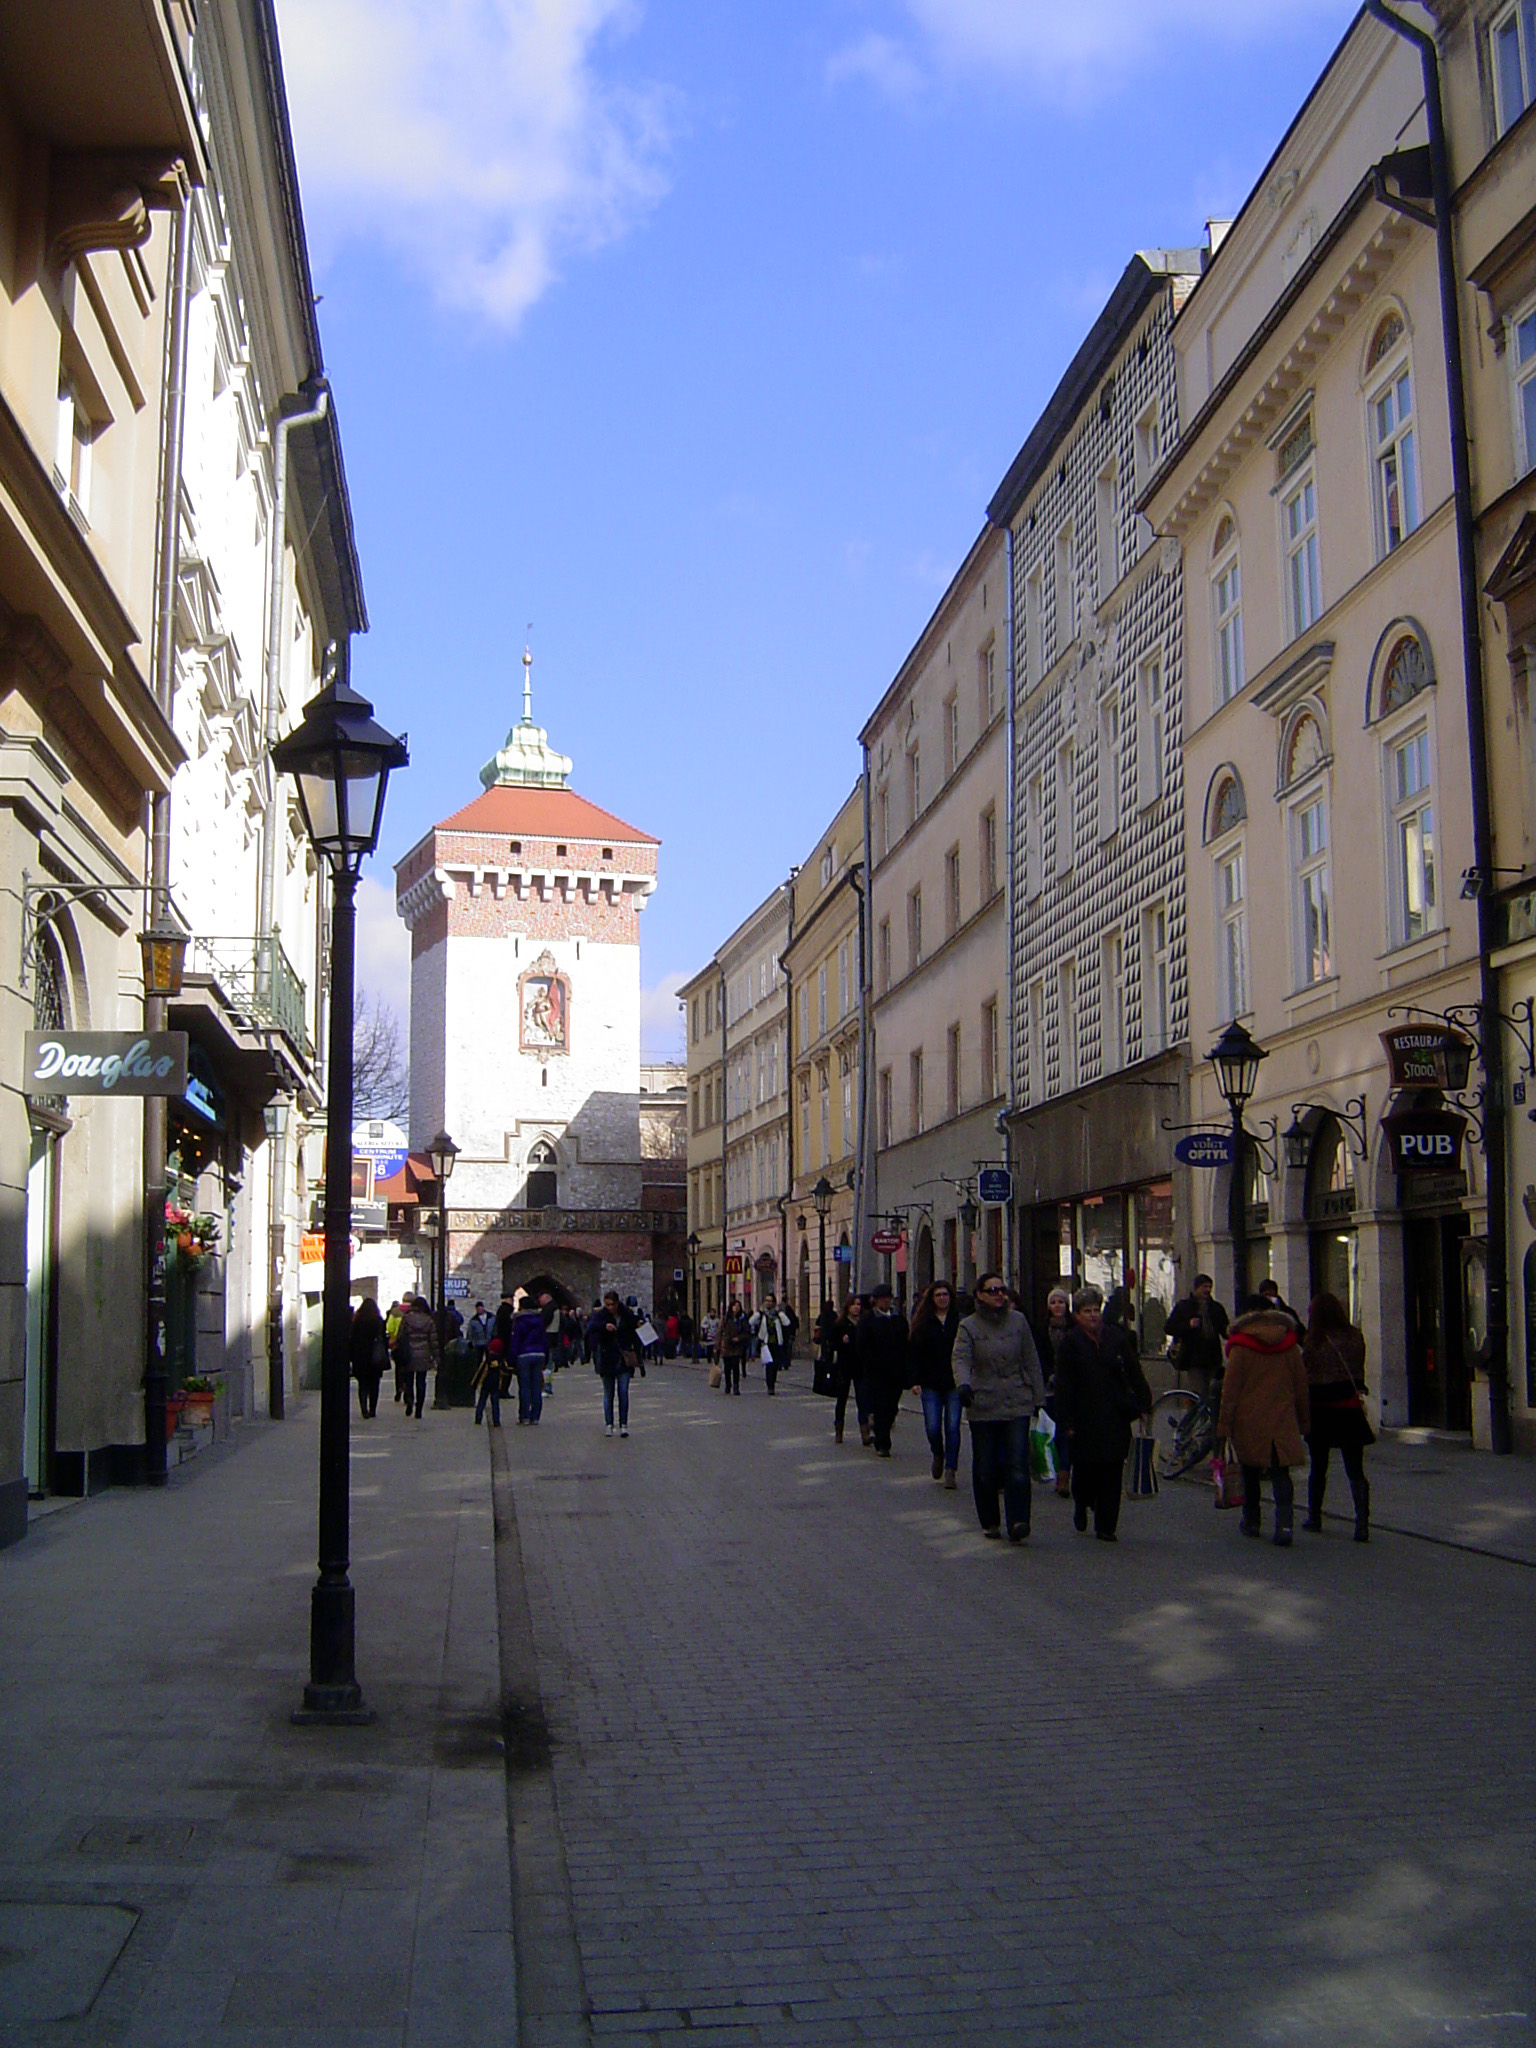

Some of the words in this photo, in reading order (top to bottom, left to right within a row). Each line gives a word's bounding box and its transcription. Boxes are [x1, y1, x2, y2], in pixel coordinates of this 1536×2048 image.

[33, 1038, 175, 1090] Douglas
[1187, 1149, 1229, 1160] OPTYK
[1399, 1134, 1453, 1156] PUB
